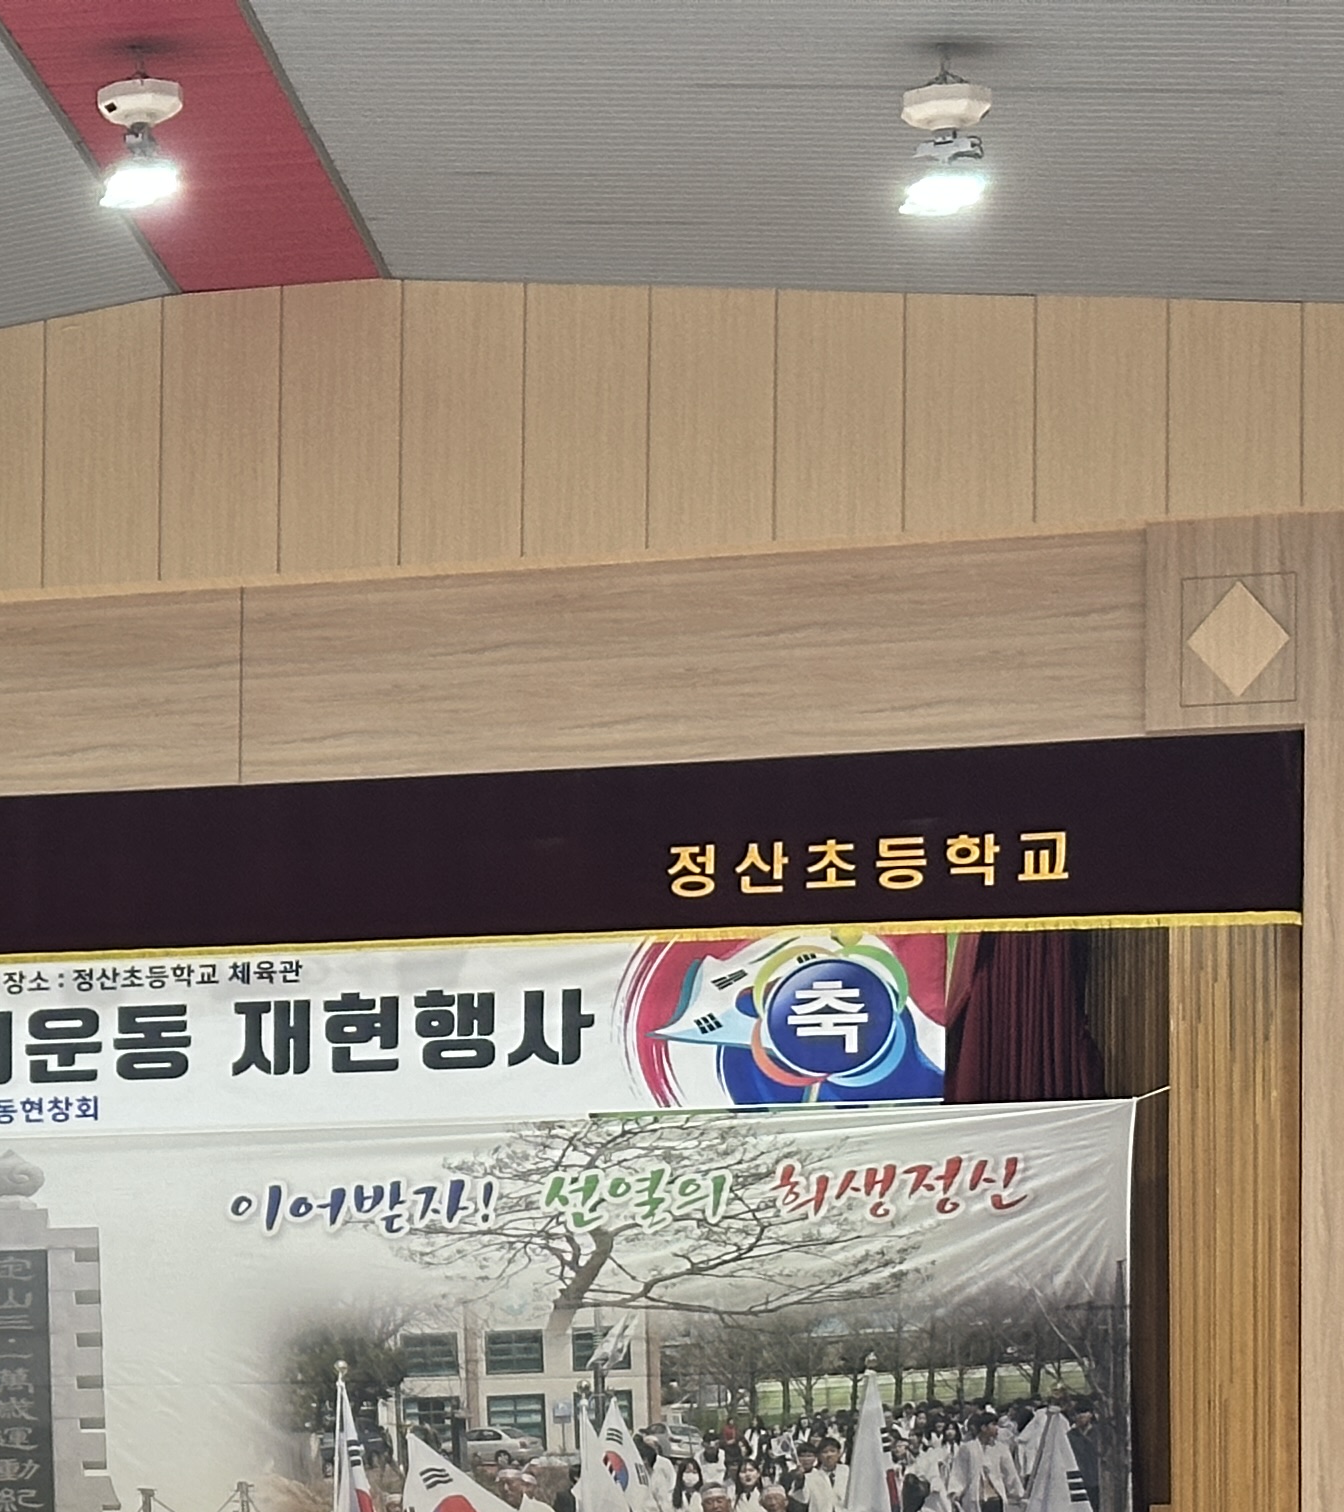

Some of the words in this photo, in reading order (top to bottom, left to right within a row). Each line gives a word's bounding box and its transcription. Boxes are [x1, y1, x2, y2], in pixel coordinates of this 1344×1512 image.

[668, 831, 1069, 897] 정산초등학교
[72, 962, 219, 991] 정산초등학교
[227, 959, 303, 986] 체육관
[232, 988, 595, 1076] 재현행사
[786, 981, 868, 1053] 축
[230, 1178, 496, 1233] 이어받자!
[541, 1170, 733, 1230] 선열의
[769, 1156, 1028, 1220] 희생정신
